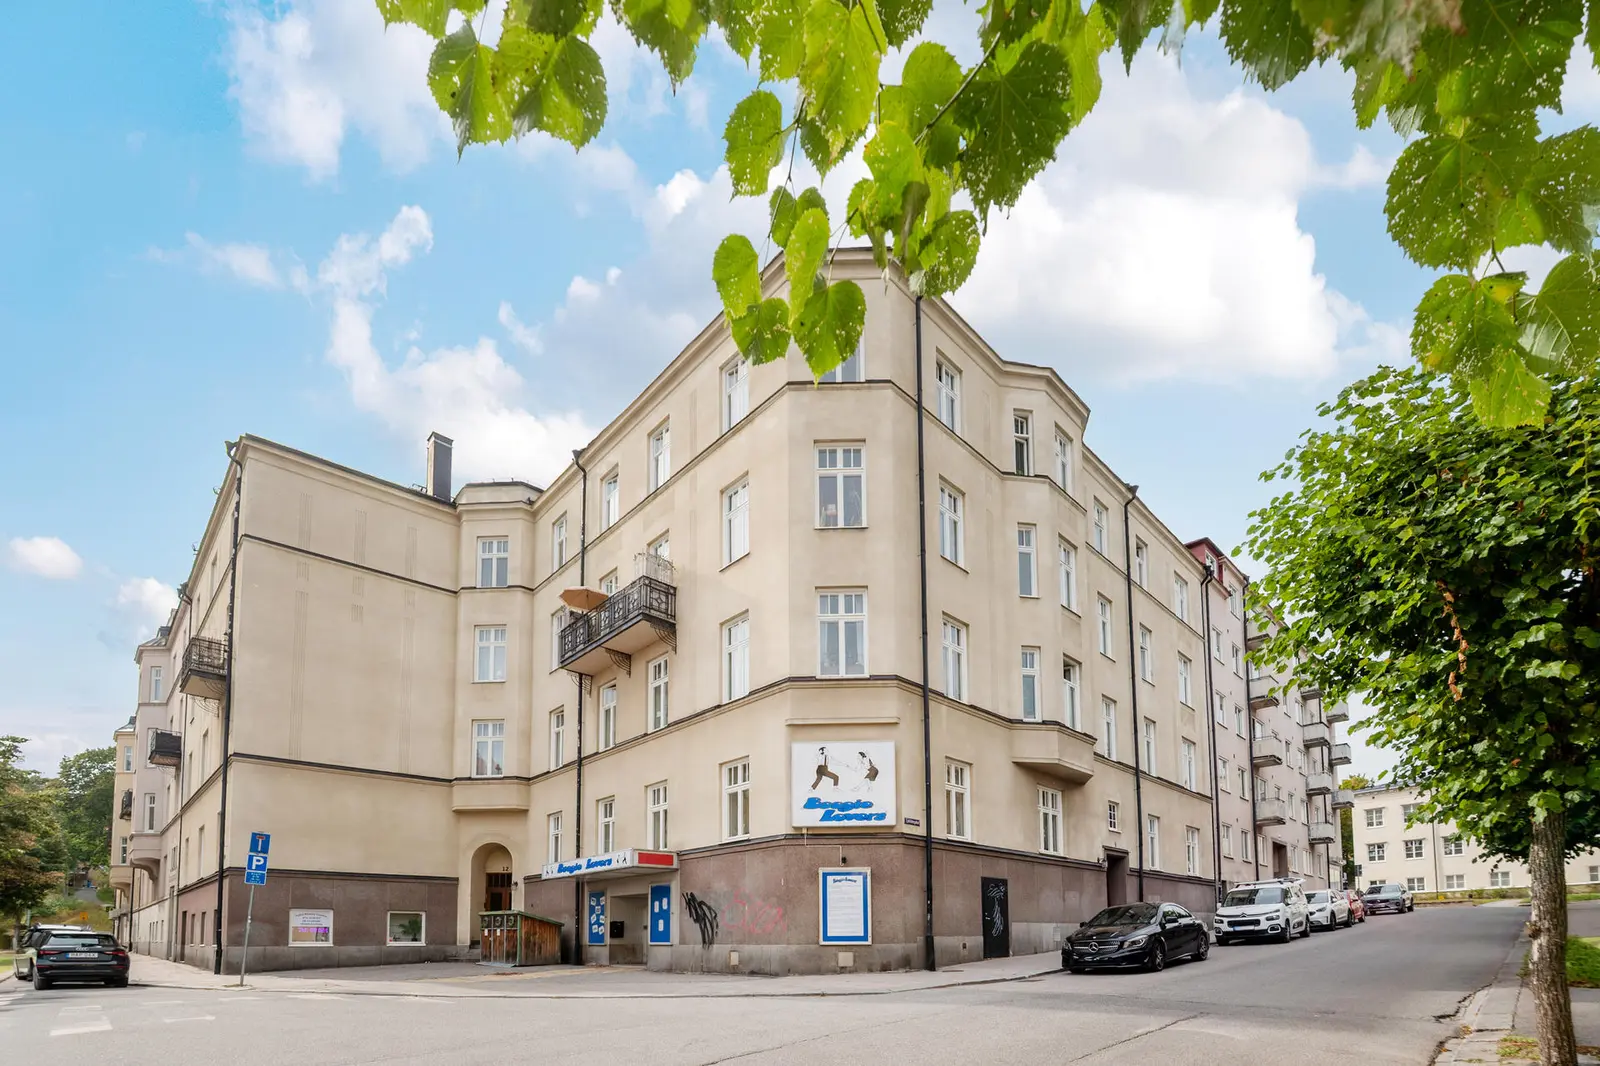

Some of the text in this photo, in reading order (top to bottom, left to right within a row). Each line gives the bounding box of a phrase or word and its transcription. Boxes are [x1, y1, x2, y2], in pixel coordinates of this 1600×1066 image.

[803, 797, 874, 812] Boogie
[819, 809, 887, 821] Lovers
[252, 856, 265, 870] P
[557, 858, 612, 874] Boogie Lovers
